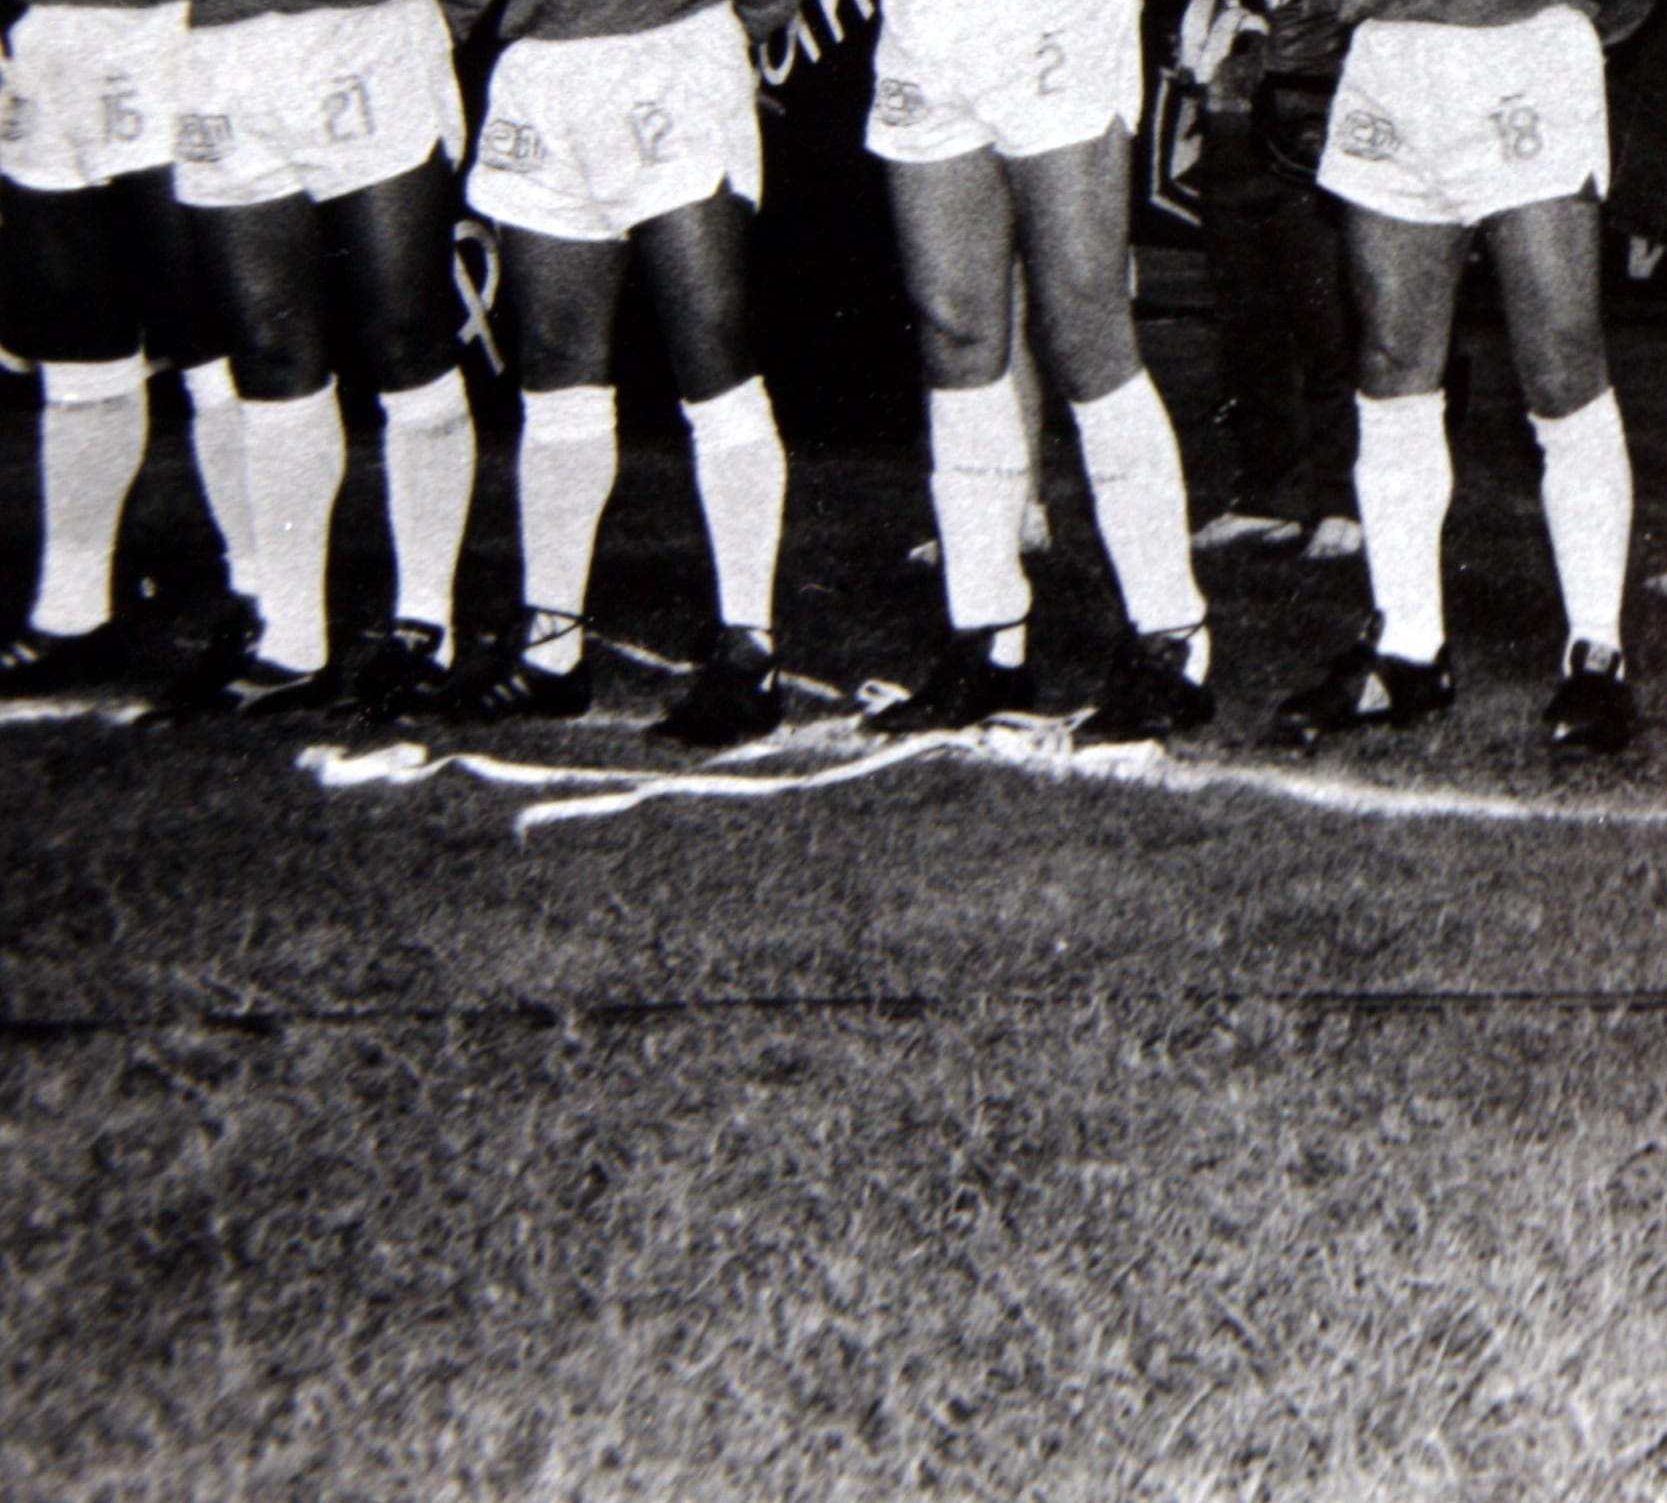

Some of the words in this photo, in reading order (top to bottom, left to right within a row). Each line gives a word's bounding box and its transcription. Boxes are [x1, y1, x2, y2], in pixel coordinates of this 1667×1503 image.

[1035, 41, 1067, 96] 2
[321, 79, 376, 144] 21
[626, 106, 676, 169] 12
[1488, 106, 1543, 160] 18
